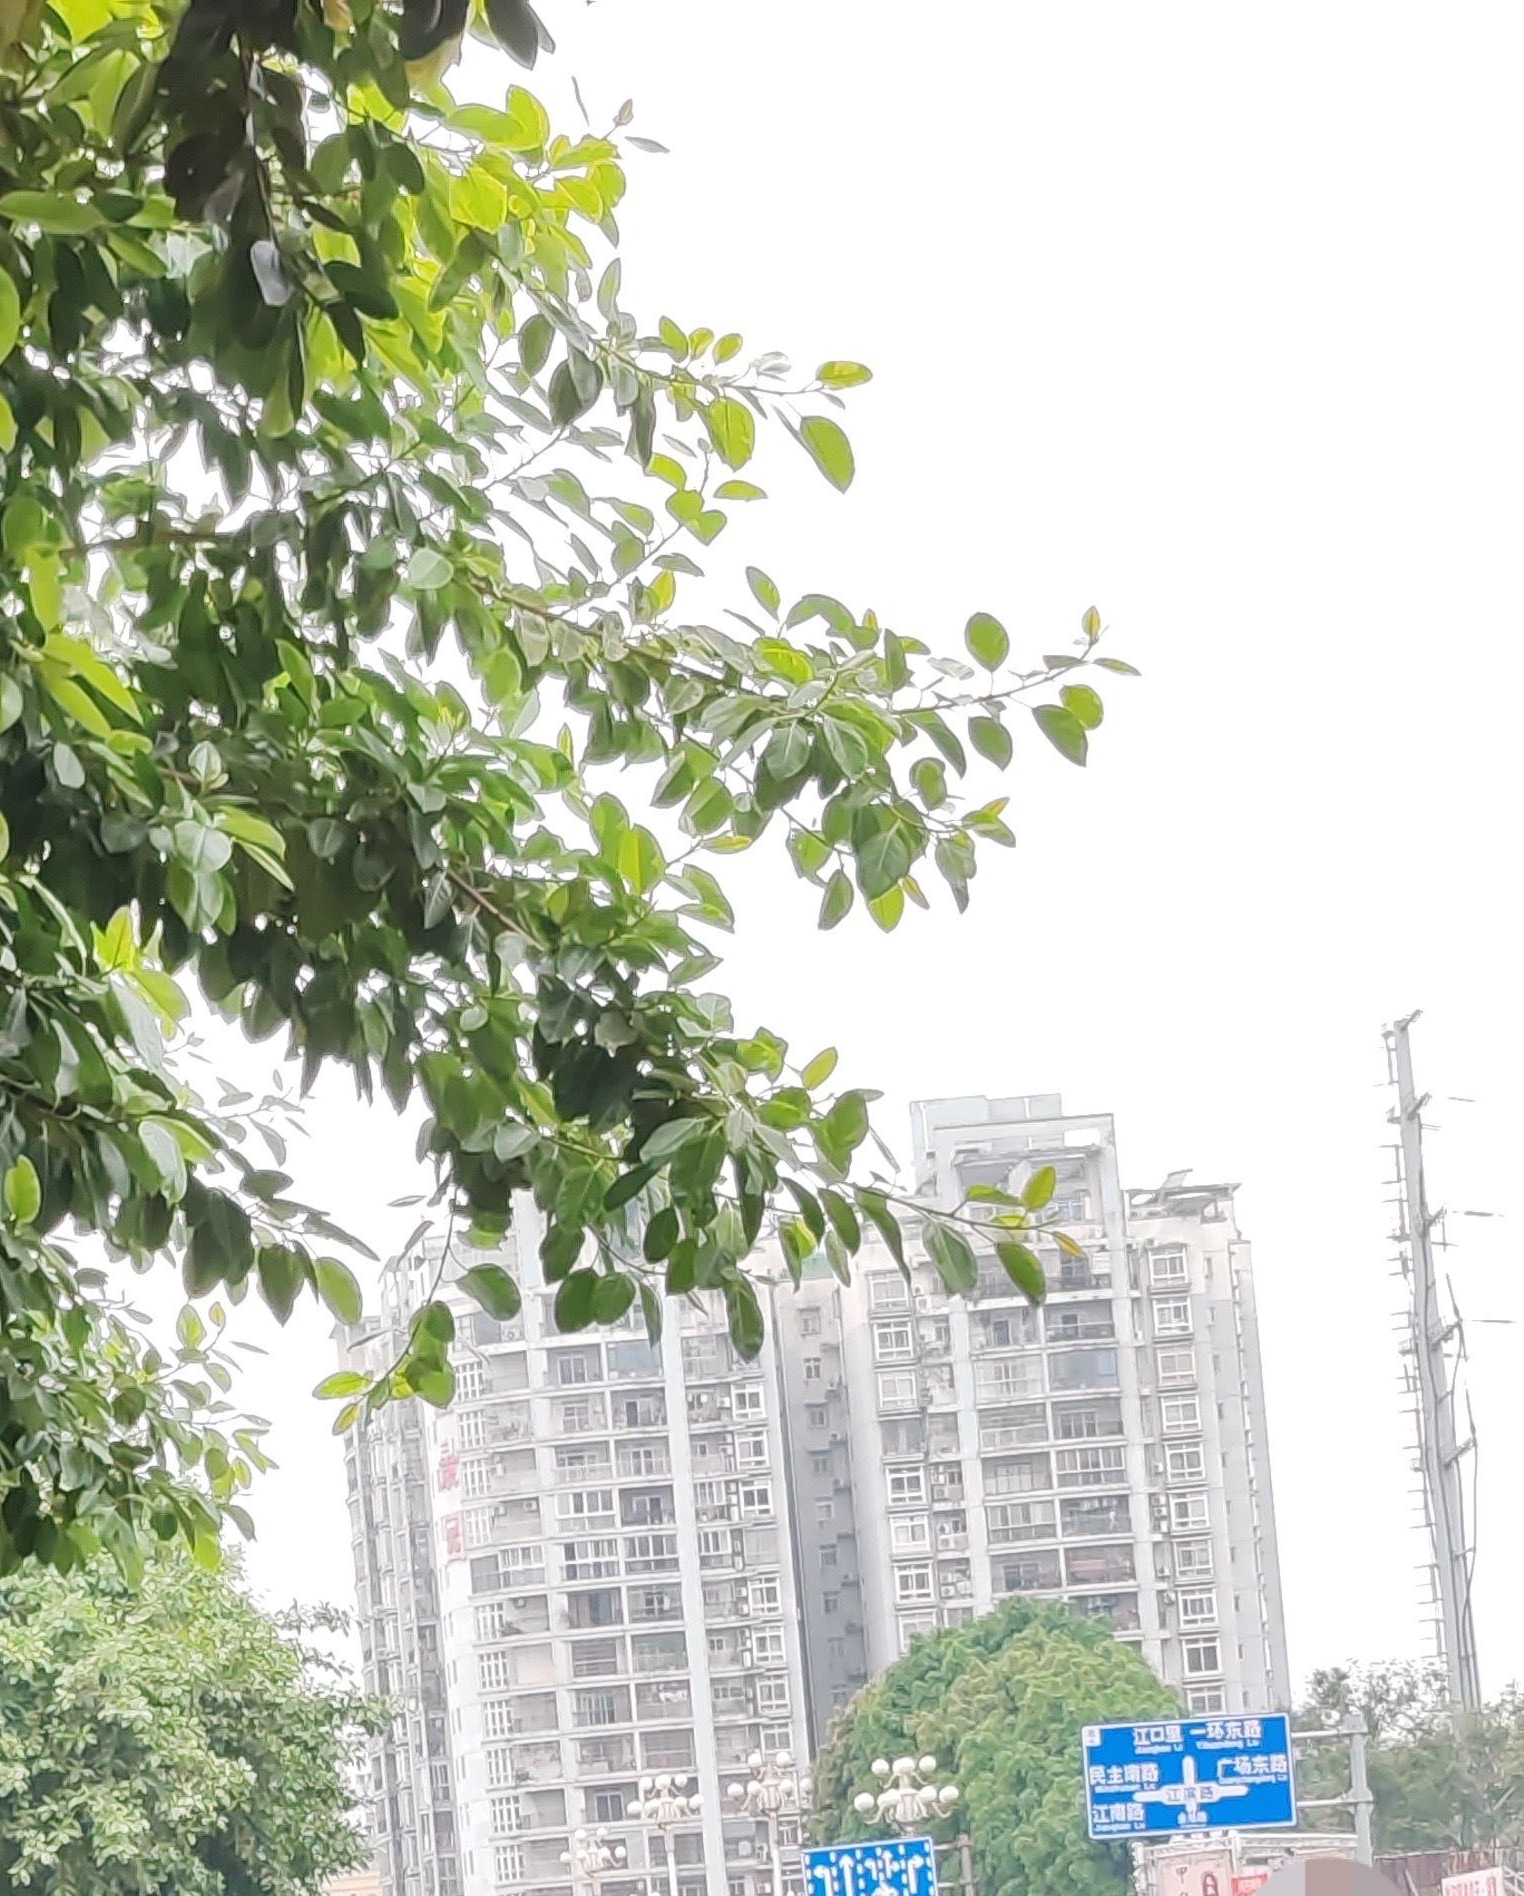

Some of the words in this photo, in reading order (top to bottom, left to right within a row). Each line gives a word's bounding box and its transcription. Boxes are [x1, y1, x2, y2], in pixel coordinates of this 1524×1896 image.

[1189, 1721, 1261, 1738] 一环东路
[1089, 1764, 1159, 1785] 民主南路
[1217, 1755, 1287, 1775] 广场东路
[1092, 1804, 1145, 1822] 江南路
